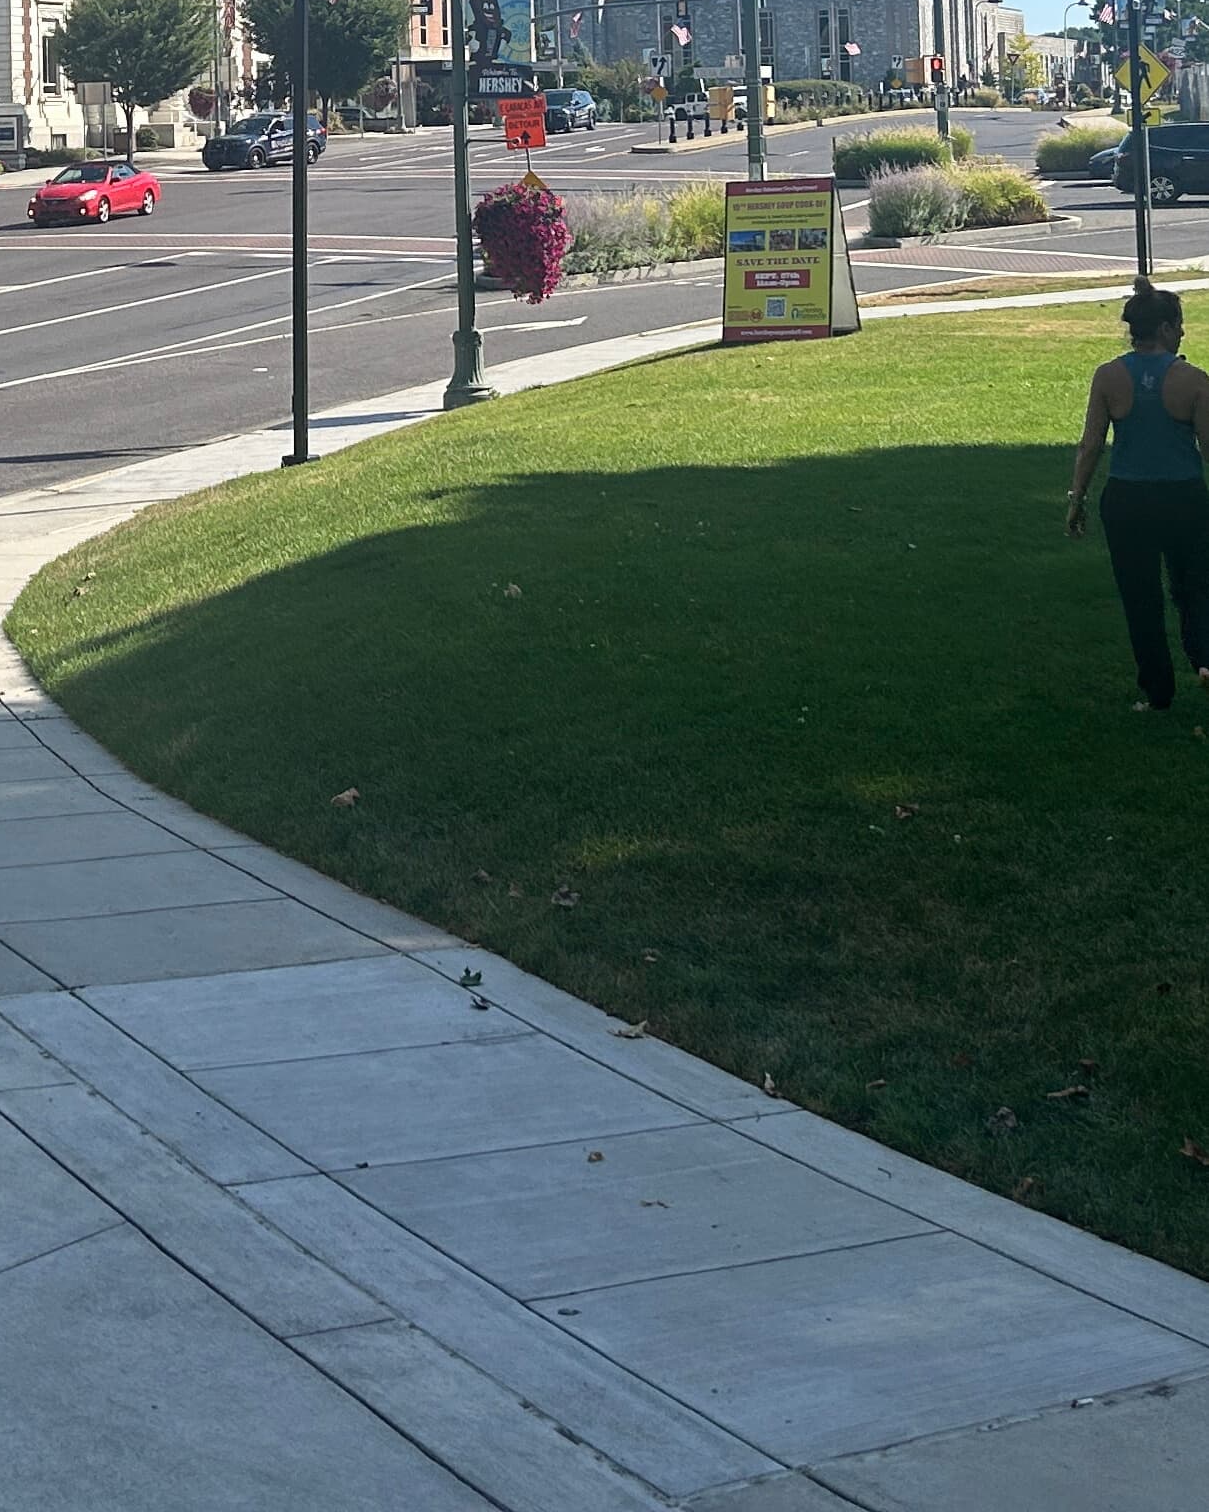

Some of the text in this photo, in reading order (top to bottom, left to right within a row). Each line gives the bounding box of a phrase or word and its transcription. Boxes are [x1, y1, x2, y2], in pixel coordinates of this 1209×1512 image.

[478, 77, 522, 93] HERSHEY
[508, 119, 540, 129] DETOUR
[735, 256, 820, 266] SAVE THE DATE
